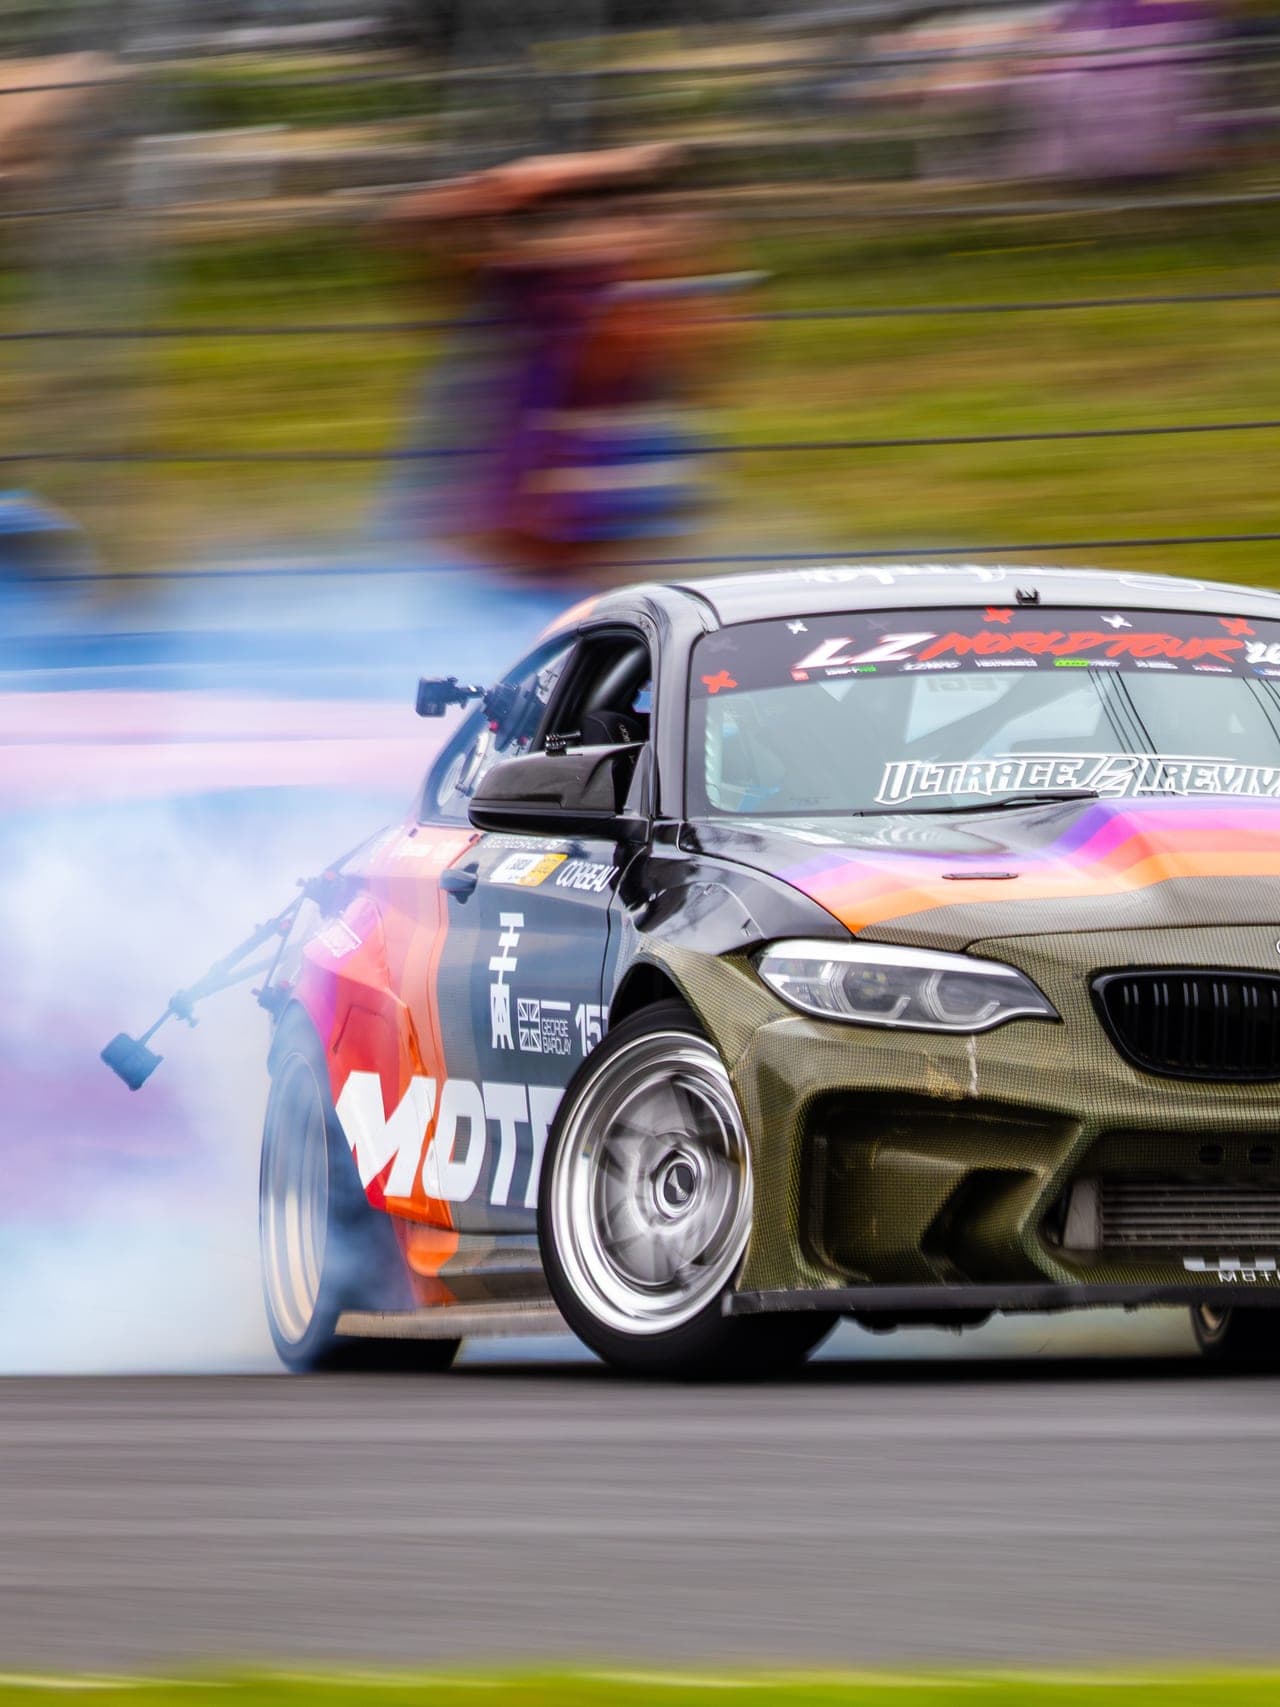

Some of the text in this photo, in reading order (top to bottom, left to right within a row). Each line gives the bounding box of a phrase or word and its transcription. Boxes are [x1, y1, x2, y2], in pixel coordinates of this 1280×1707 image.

[873, 758, 1085, 804] ULTRACE
[556, 860, 620, 893] CORBEAU
[541, 1018, 569, 1037] GEORGE
[542, 1036, 572, 1056] BARCLAY
